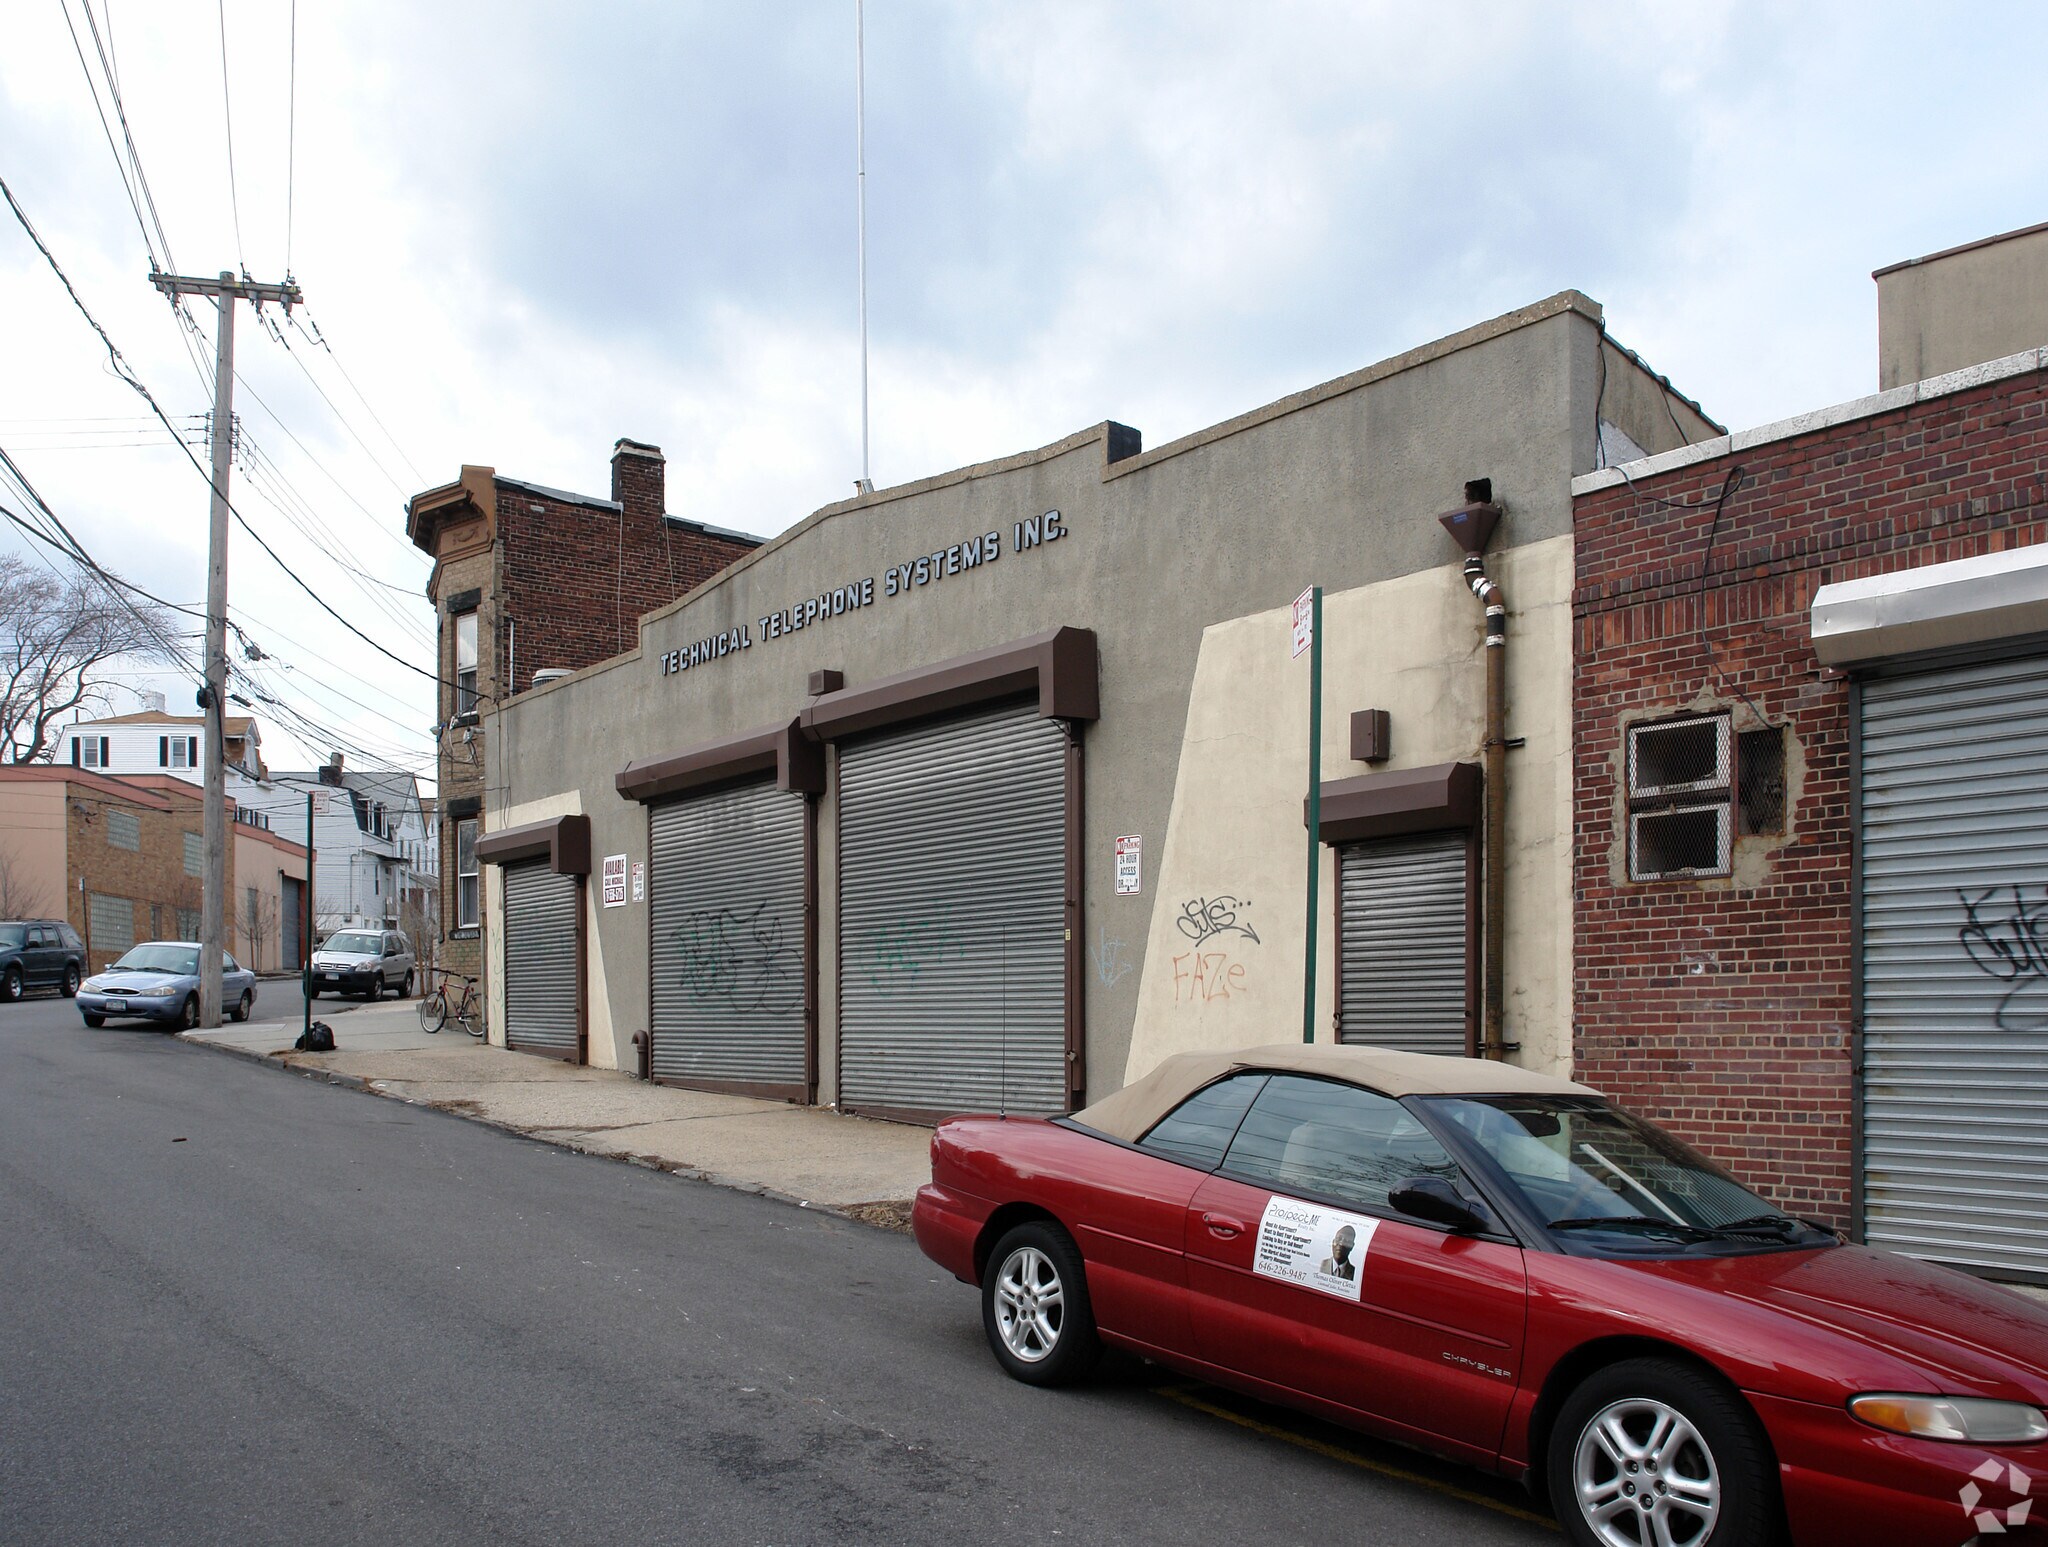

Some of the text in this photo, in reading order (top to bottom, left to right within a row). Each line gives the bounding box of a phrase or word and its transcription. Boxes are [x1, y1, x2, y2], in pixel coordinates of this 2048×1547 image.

[660, 509, 1068, 676] TECHNICAL TELEPHONE SYSTEMS INC.
[1258, 1261, 1307, 1280] 646-226-9487
[1442, 1352, 1512, 1379] CHRYSLER
